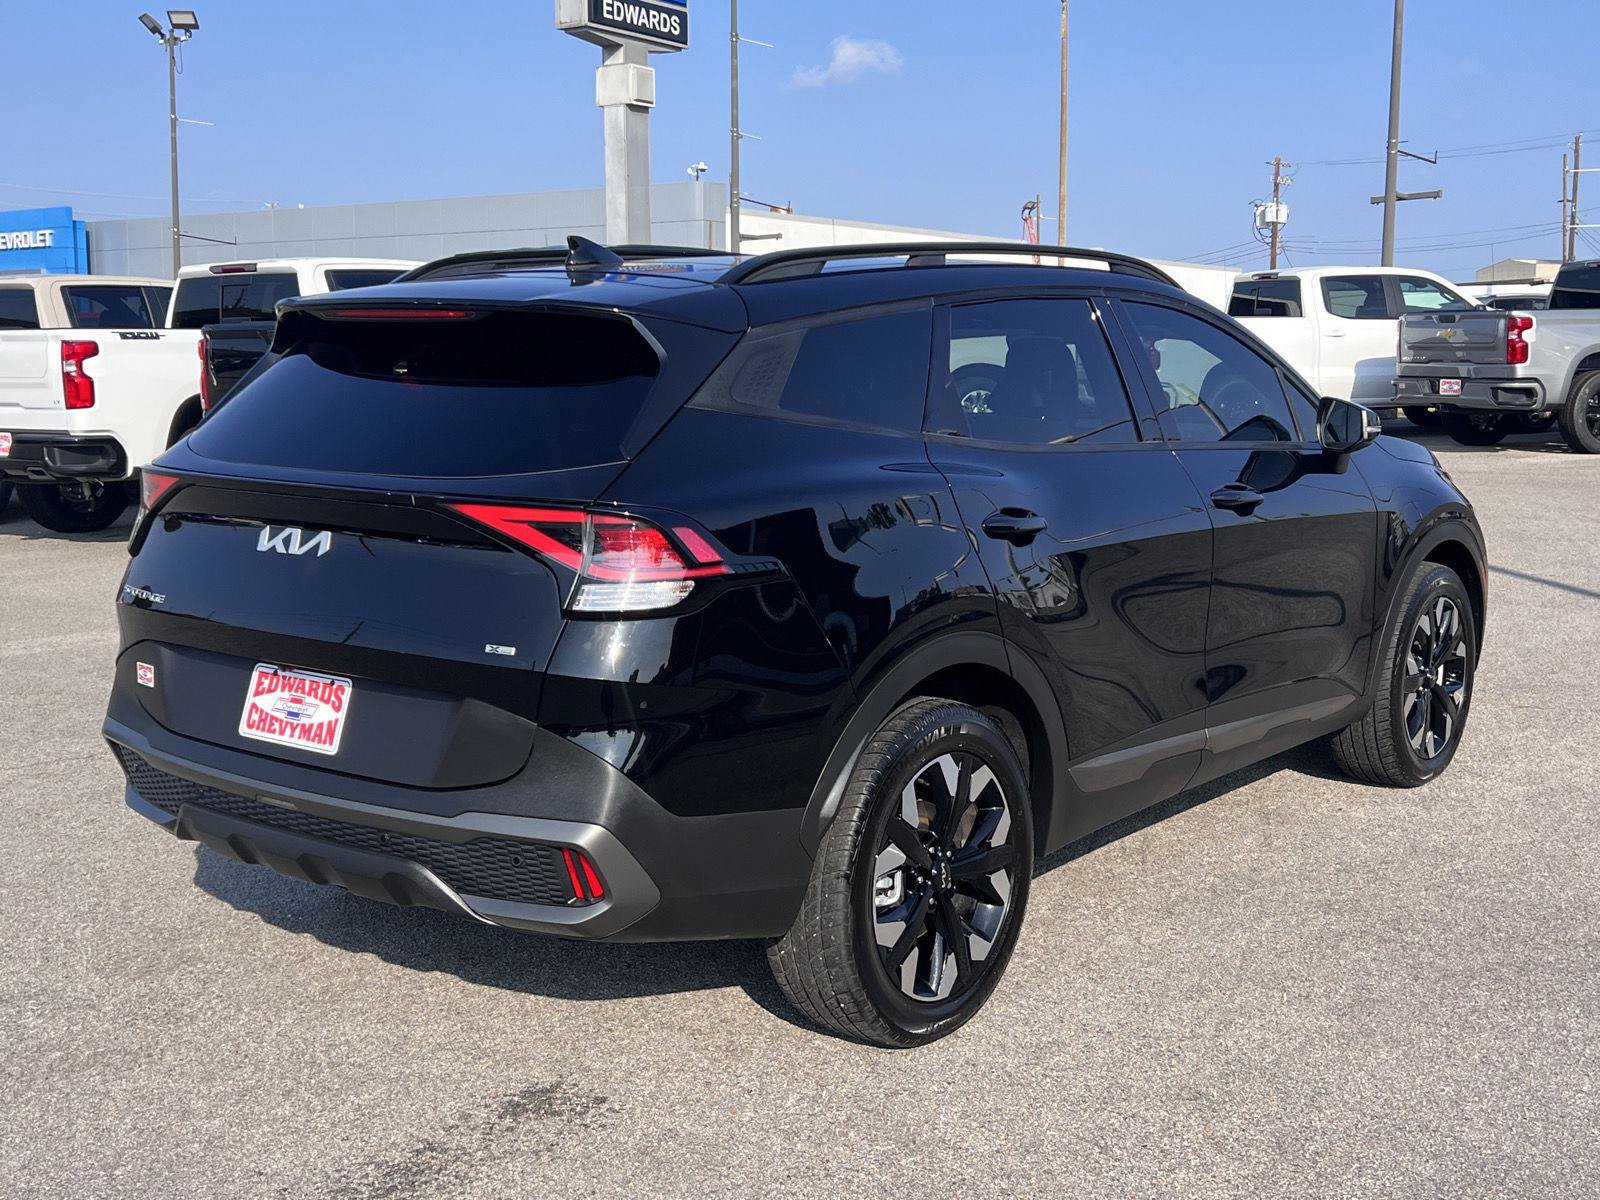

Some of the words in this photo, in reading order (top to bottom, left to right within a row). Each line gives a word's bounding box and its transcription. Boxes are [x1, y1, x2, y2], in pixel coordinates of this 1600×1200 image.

[603, 0, 680, 35] EDWARDS
[0, 229, 55, 250] EVROLET
[256, 525, 331, 557] KIA
[252, 671, 346, 714] EDWARDS
[246, 702, 340, 747] CHEVYMAN
